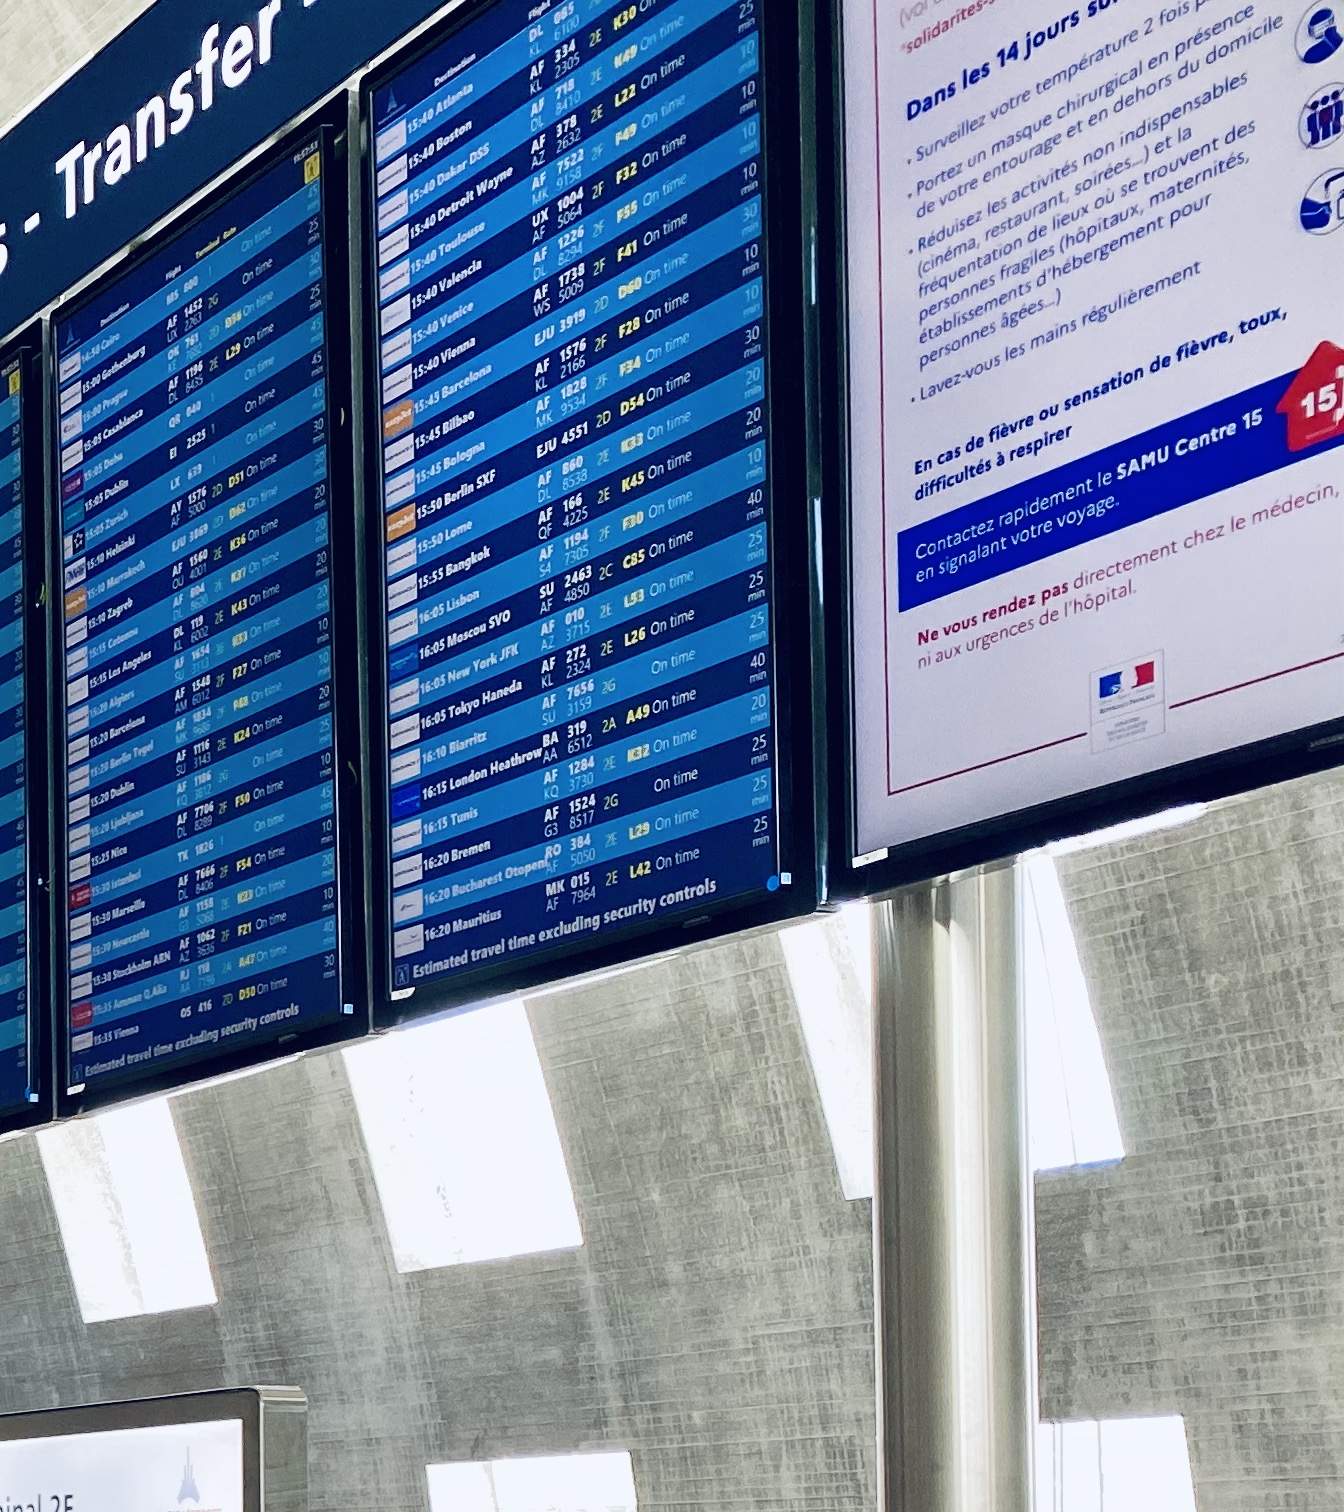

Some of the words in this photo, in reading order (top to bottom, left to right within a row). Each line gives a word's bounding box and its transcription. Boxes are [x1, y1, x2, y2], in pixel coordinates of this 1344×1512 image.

[56, 0, 282, 220] Transfer
[906, 80, 957, 121] Dans
[962, 61, 990, 90] les
[996, 40, 1020, 68] 14
[1023, 8, 1081, 61] jours
[915, 114, 986, 162] Surveillez
[989, 89, 1031, 120] votre
[1035, 28, 1139, 95] température
[1143, 16, 1153, 36] 2
[1158, 0, 1189, 26] fois
[915, 161, 963, 196] Portez
[967, 149, 986, 168] un
[991, 113, 1052, 156] masque
[1056, 60, 1143, 119] chirurgical
[1147, 50, 1169, 70] en
[1174, 4, 1254, 62] présence
[410, 214, 435, 240] 15:40
[438, 187, 474, 220] Detroit
[477, 166, 513, 202] Wayne
[531, 134, 546, 154] AF
[556, 114, 577, 139] 378
[615, 85, 636, 108] L22
[641, 72, 657, 90] On
[660, 53, 685, 78] time
[917, 209, 982, 253] Réduisez
[986, 196, 1007, 217] les
[1011, 159, 1077, 204] activités
[1082, 140, 1115, 166] non
[1119, 71, 1247, 147] indispensables
[914, 458, 932, 475] En
[936, 445, 961, 465] cas
[964, 435, 984, 453] de
[987, 414, 1034, 443] fièvre
[1038, 403, 1059, 421] ou
[1063, 366, 1144, 411] sensation
[1149, 354, 1171, 373] de
[1175, 330, 1234, 362] fièvre,
[1237, 306, 1287, 335] toux,
[919, 354, 1001, 400] Lavez-vous
[1004, 342, 1025, 361] les
[1029, 319, 1077, 350] mains
[1081, 260, 1201, 326] régulièrement
[416, 494, 442, 520] 15:50
[444, 481, 475, 507] Berlin
[477, 469, 496, 491] SXF
[536, 437, 557, 459] EJU
[561, 421, 588, 446] 4551
[620, 393, 644, 417] D54
[646, 384, 663, 402] On
[666, 370, 691, 393] time
[914, 458, 992, 501] difficultés
[995, 450, 1005, 467] à
[1009, 424, 1071, 462] respirer
[915, 518, 994, 559] Contactez
[998, 478, 1093, 527] rapidement
[1097, 471, 1112, 488] le
[1116, 444, 1169, 480] SAMU
[1174, 422, 1237, 456] Centre
[1242, 406, 1262, 429] 15
[419, 638, 445, 659] 16:05
[447, 618, 486, 649] Moscou
[489, 609, 511, 630] SVO
[539, 582, 554, 599] SU
[564, 565, 592, 588] 2463
[623, 548, 645, 569] C85
[915, 566, 933, 582] en
[938, 536, 1007, 574] signalant
[1010, 519, 1053, 545] votre
[1055, 495, 1119, 528] voyage.
[917, 628, 939, 646] Ne
[941, 614, 977, 636] vous
[981, 593, 1036, 623] rendez
[1040, 581, 1069, 606] pas
[1073, 540, 1177, 589] directement
[1183, 524, 1224, 549] chez
[1230, 516, 1245, 532] le
[1251, 484, 1338, 523] médecin,
[420, 708, 446, 729] 16:05
[449, 697, 480, 723] Tokyo
[482, 679, 522, 708] Haneda
[916, 655, 932, 670] ni
[934, 644, 962, 665] aux
[965, 618, 1035, 653] urgences
[1038, 607, 1060, 627] de
[422, 779, 447, 800] 16:15
[450, 760, 488, 791] London
[490, 746, 542, 776] Heathrow
[543, 731, 559, 747] BA
[567, 720, 587, 739] 319
[626, 704, 650, 725] A49
[412, 948, 468, 978] Estimated
[470, 937, 505, 961] travel
[507, 933, 535, 951] time
[537, 913, 600, 942] excluding
[603, 897, 656, 924] security
[659, 876, 716, 907] controls
[425, 922, 451, 942] 16:20
[453, 908, 502, 934] Mauritius
[546, 877, 565, 896] MK
[571, 871, 590, 889] 015
[630, 860, 651, 879] L42
